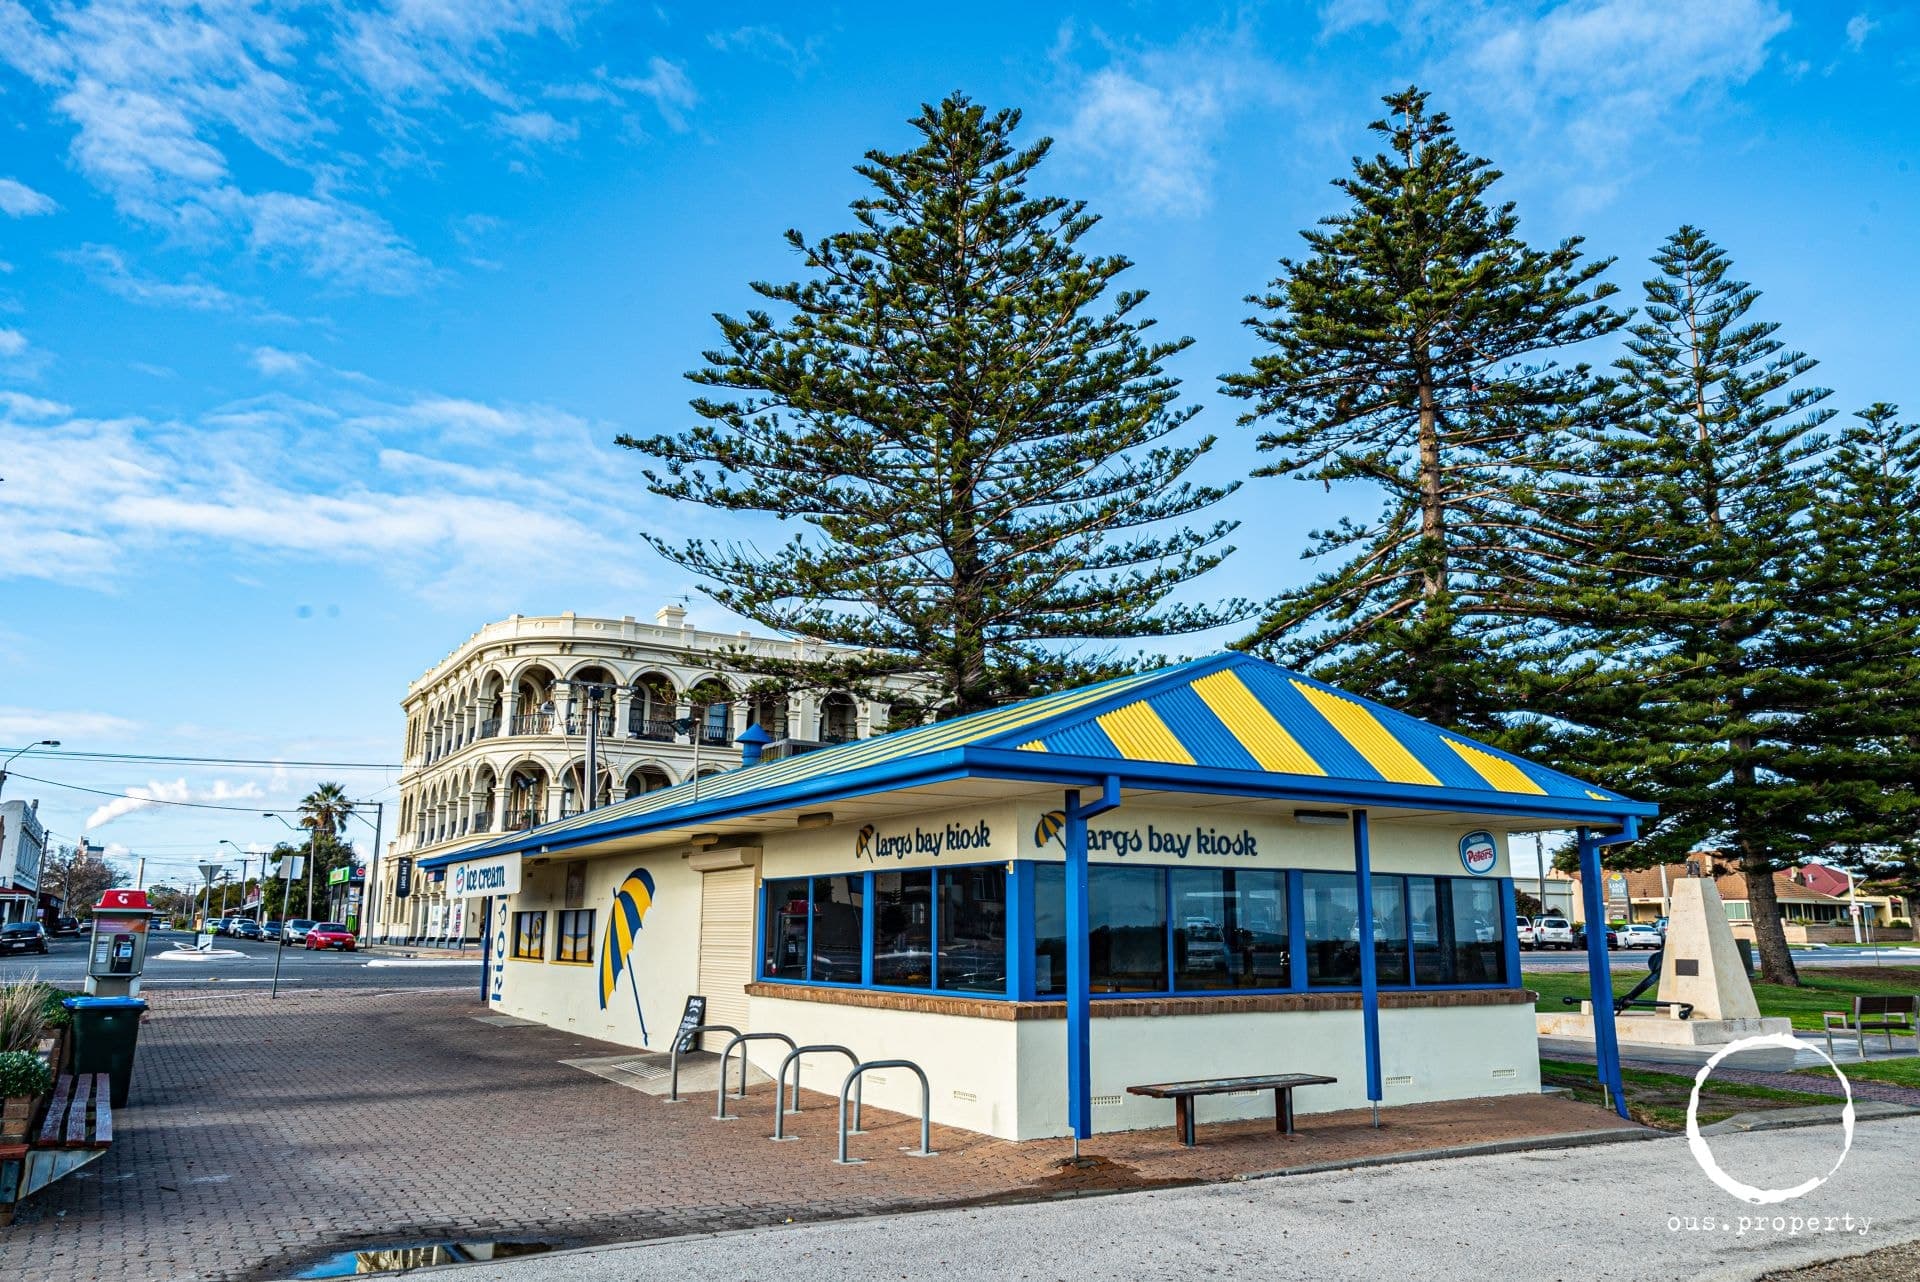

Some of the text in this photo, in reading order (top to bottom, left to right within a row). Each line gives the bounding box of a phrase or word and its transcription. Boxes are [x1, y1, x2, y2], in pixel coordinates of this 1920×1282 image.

[876, 819, 991, 860] largs bay kiosk
[1087, 825, 1258, 858] args bay kiosk
[1467, 848, 1493, 863] Peters
[466, 864, 505, 891] ice cream
